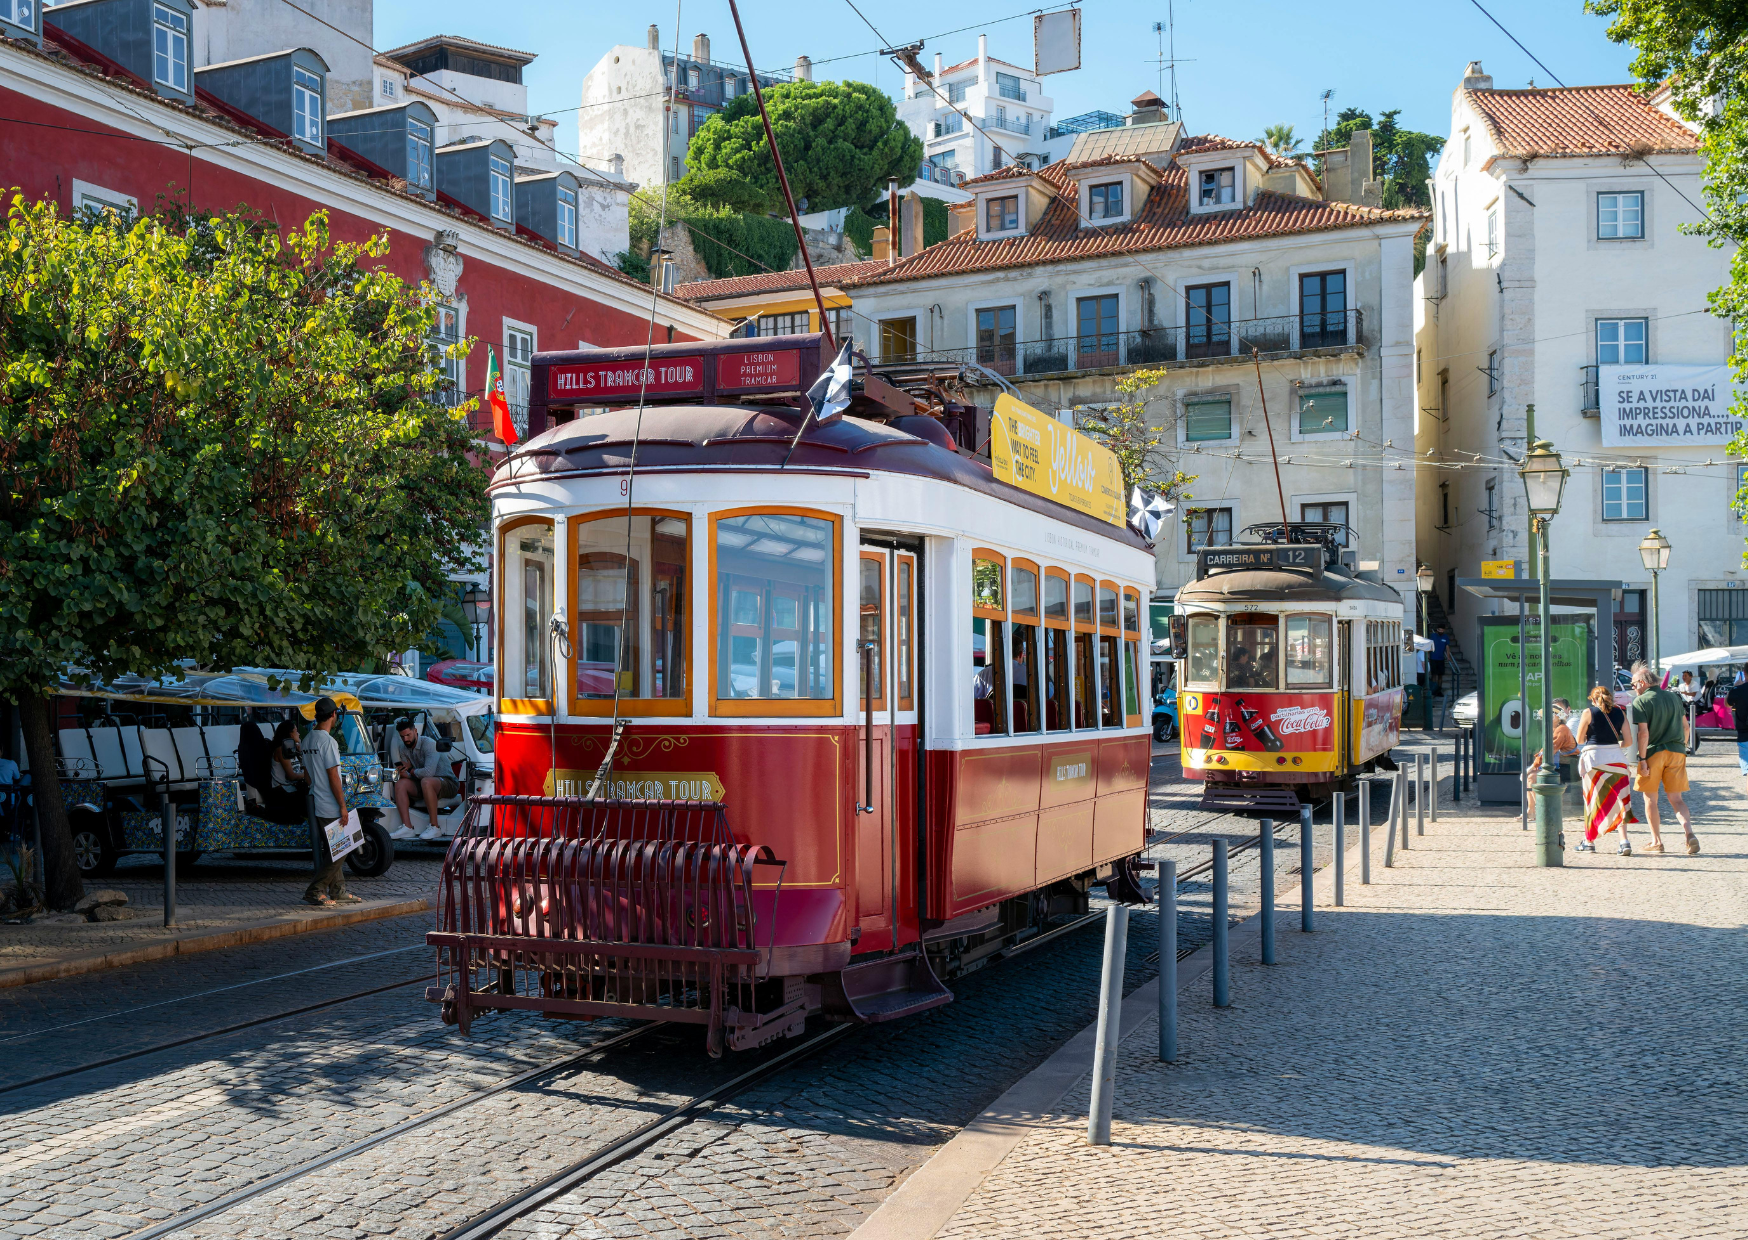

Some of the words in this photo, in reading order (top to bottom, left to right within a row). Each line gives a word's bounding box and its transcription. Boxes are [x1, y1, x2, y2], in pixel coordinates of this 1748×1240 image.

[744, 353, 774, 364] LISBON
[557, 372, 596, 390] HILLS
[598, 368, 656, 388] TRAMCAR
[658, 365, 694, 384] TOUR
[740, 364, 777, 374] PREMIUM
[740, 375, 777, 385] TRAMCAR
[1617, 390, 1633, 404] SE
[1636, 389, 1647, 403] A
[1649, 388, 1689, 403] VISTA
[1691, 384, 1716, 402] DAÍ
[1008, 416, 1018, 436] THE
[1018, 421, 1040, 446] BRIGHTER
[1619, 422, 1680, 437] IMAGINA
[1682, 422, 1694, 436] A
[1010, 437, 1022, 457] WAY
[1022, 443, 1029, 460] TO
[1029, 446, 1040, 466] FEEL
[1047, 423, 1096, 494] Yellow
[620, 479, 628, 497] 9
[1207, 554, 1255, 565] CARREIRA
[1287, 550, 1305, 563] 12
[668, 780, 713, 800] TOUR
